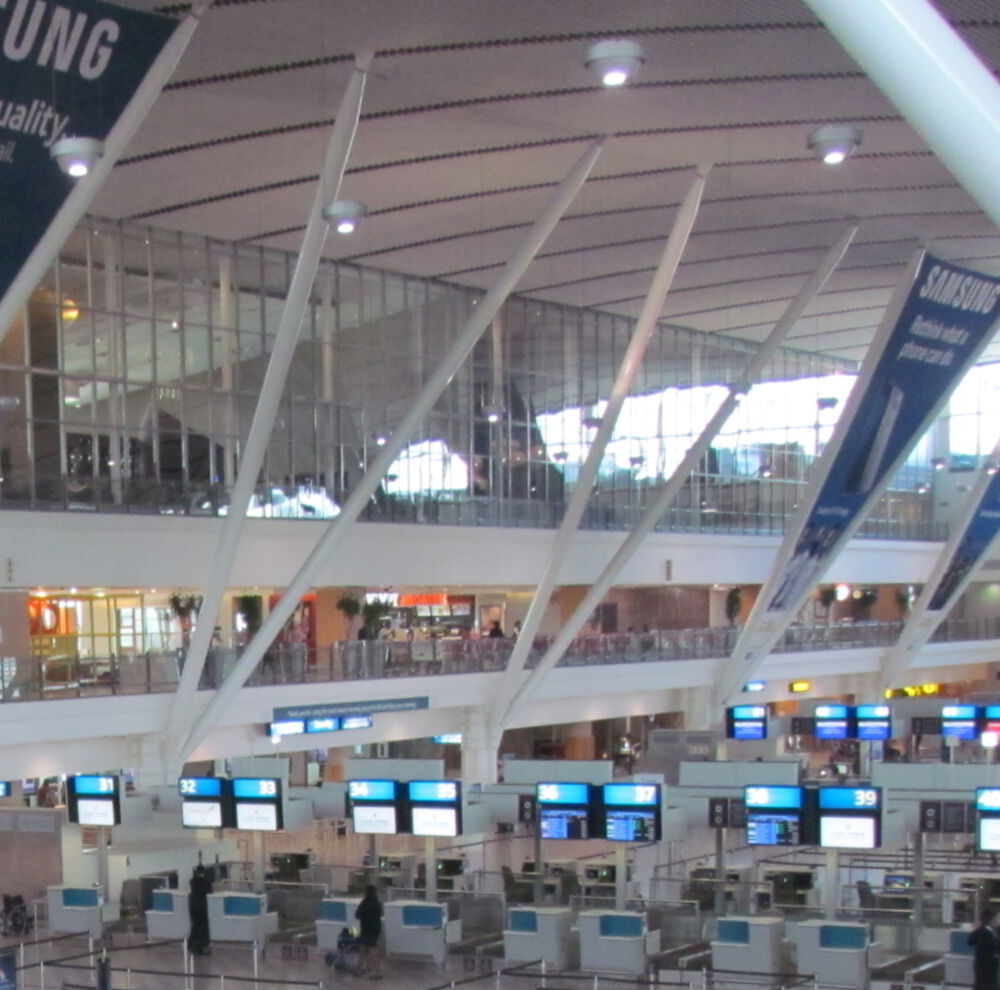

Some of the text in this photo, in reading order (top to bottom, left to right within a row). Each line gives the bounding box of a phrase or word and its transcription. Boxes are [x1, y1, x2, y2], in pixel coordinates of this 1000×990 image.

[920, 265, 1000, 314] SAMSUNG
[99, 778, 114, 791] 31
[180, 779, 196, 793] 32
[259, 780, 276, 795] 33
[350, 782, 368, 797] 34
[634, 785, 656, 802] 37
[855, 790, 877, 806] 39
